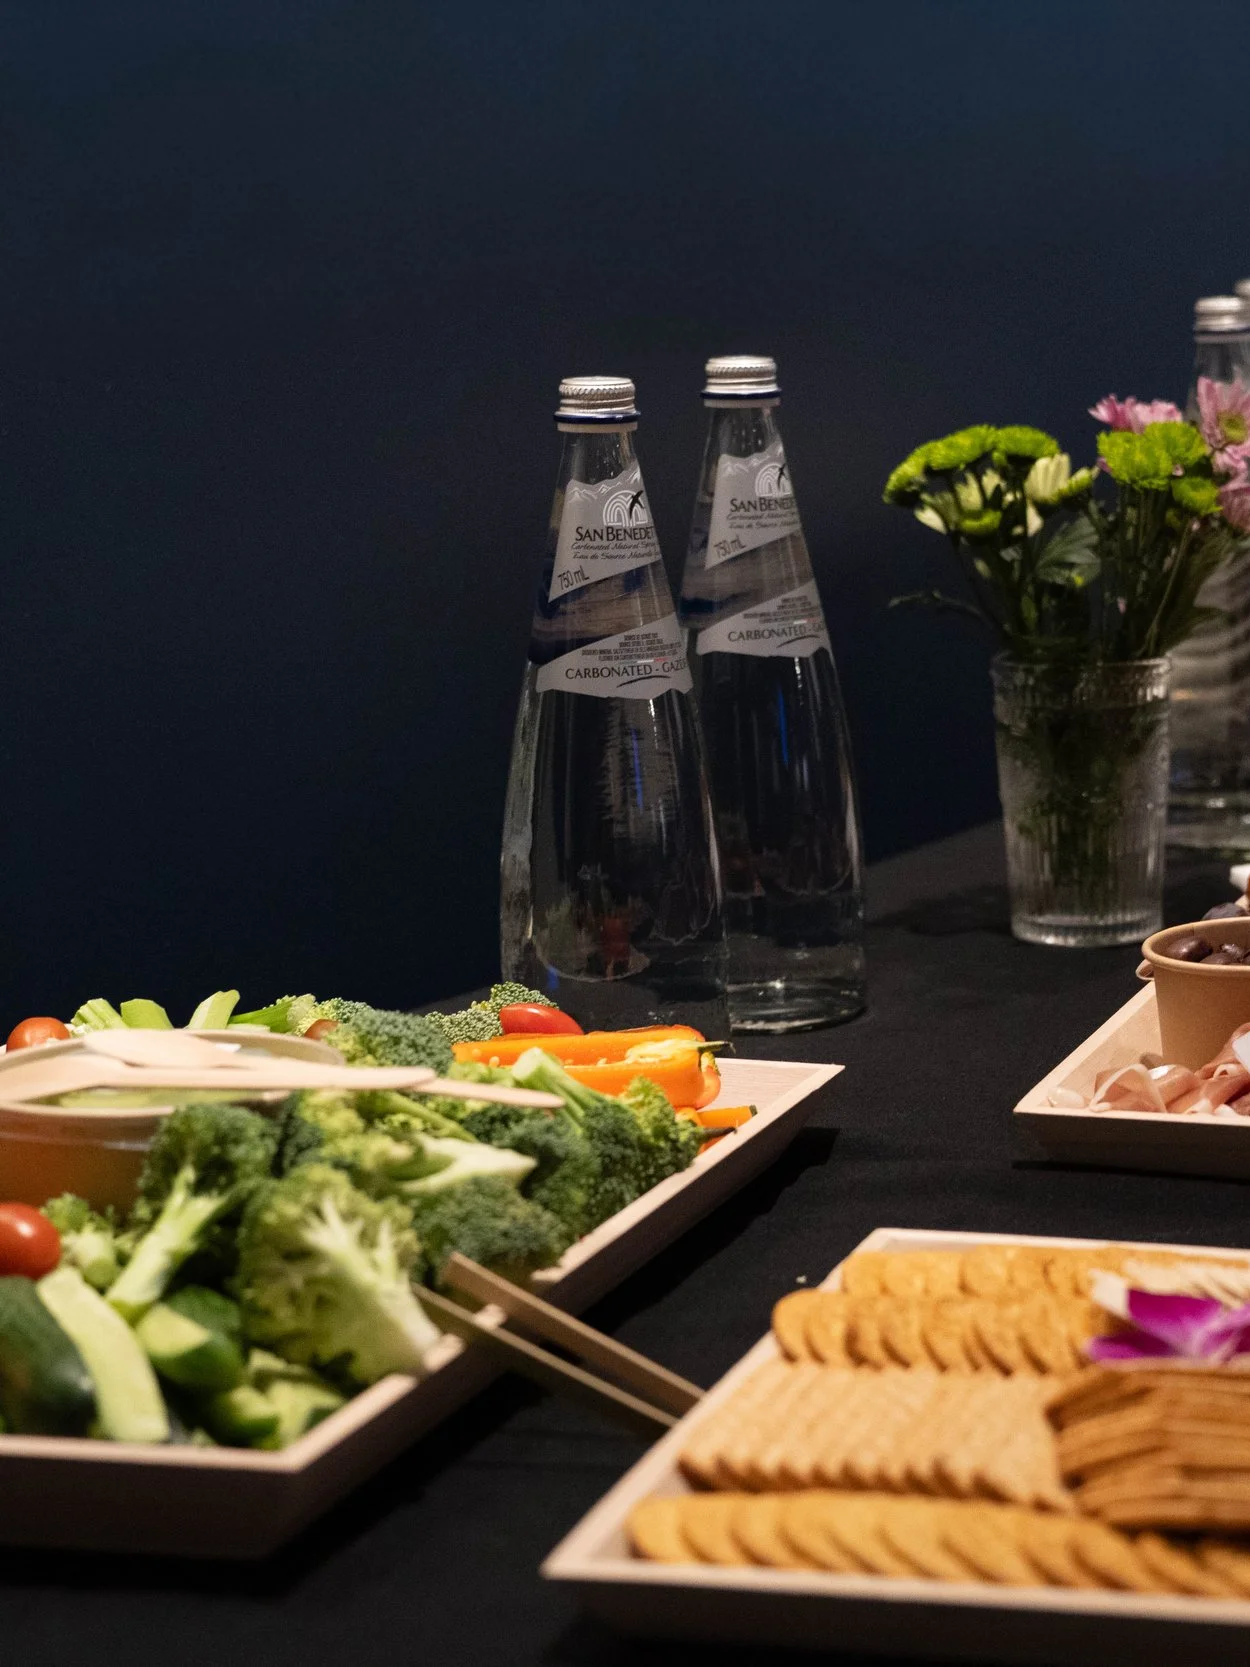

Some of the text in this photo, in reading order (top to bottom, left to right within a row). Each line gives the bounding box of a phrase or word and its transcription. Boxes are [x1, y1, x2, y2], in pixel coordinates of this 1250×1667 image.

[730, 498, 757, 512] SAN
[575, 526, 603, 541] SAN
[558, 570, 573, 590] 750
[728, 625, 806, 642] CARBONATED
[565, 664, 653, 680] CARBONATED
